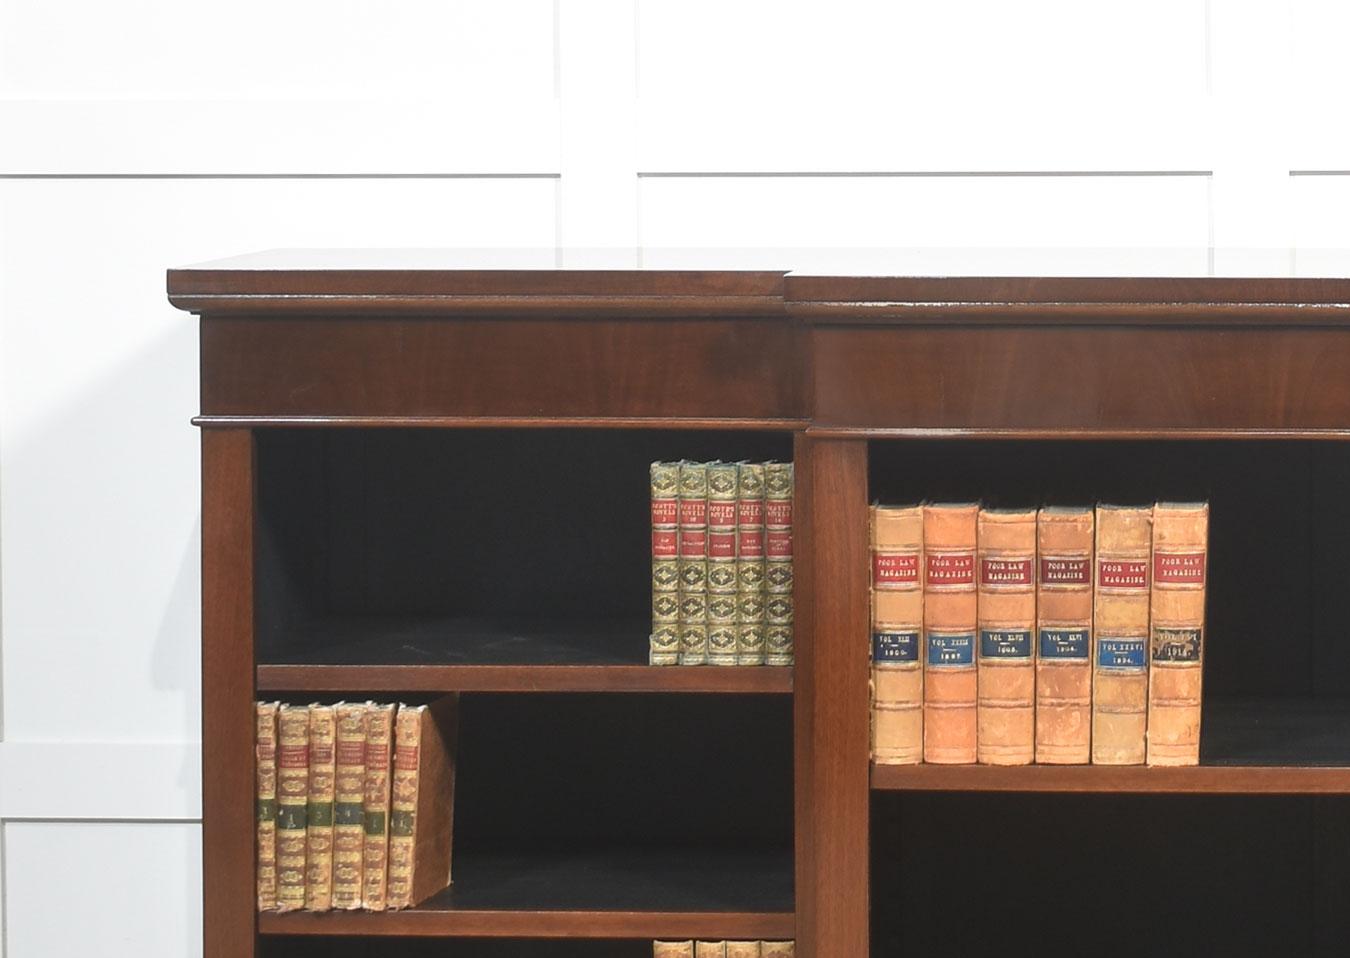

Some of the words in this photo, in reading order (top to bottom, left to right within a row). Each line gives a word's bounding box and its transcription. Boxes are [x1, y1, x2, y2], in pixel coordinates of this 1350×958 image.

[880, 569, 916, 577] MAGAZINE
[929, 570, 972, 578] MAGAZINE
[1163, 569, 1201, 577] MAGAZINE
